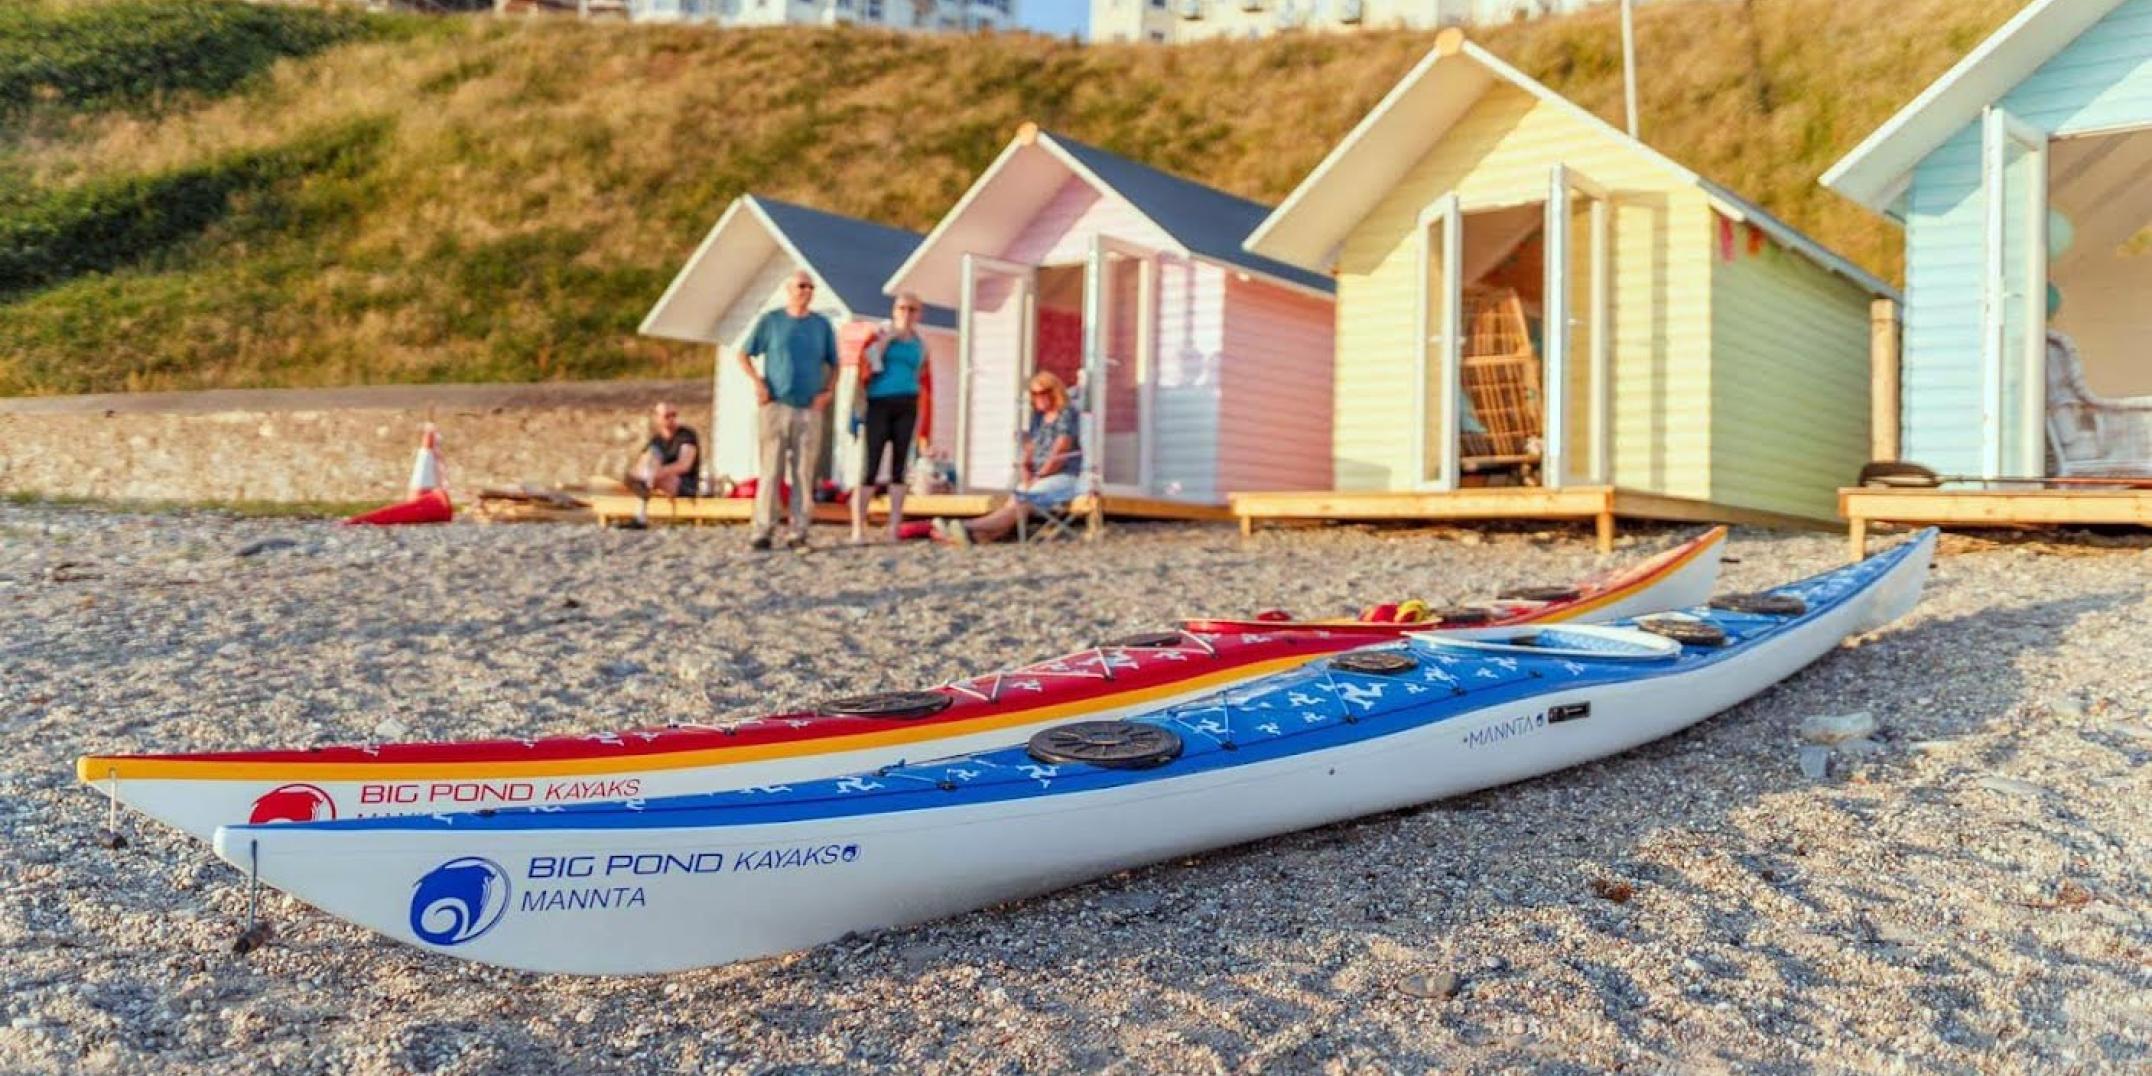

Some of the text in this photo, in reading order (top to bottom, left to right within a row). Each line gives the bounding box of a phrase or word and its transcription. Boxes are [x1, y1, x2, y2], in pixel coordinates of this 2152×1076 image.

[1469, 715, 1534, 749] MANNTA
[360, 779, 641, 804] BIG POND KAYAKS
[528, 845, 840, 878] BIG POND KAYAKS
[520, 887, 646, 912] MANNTA
